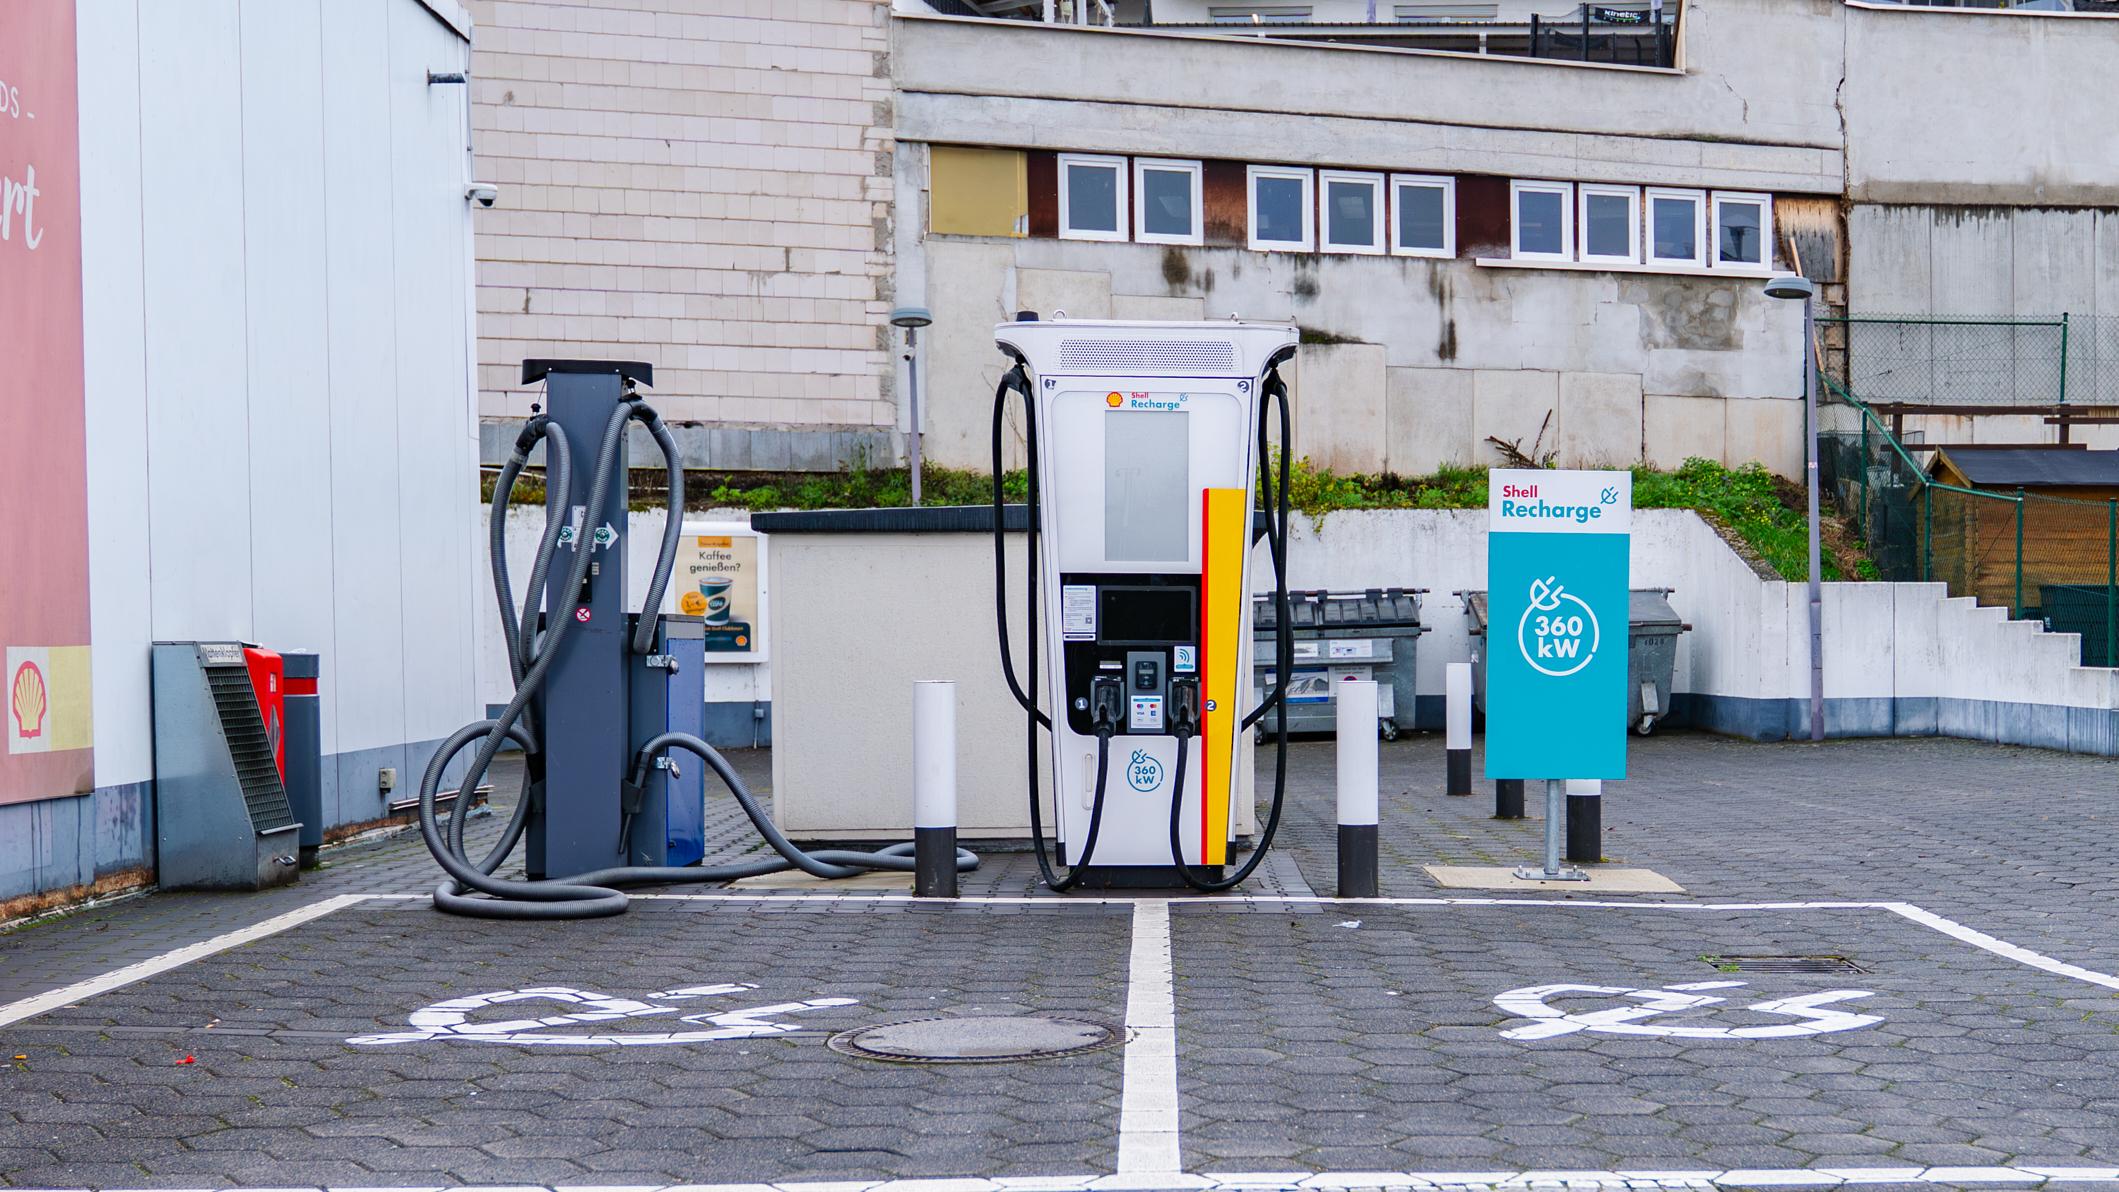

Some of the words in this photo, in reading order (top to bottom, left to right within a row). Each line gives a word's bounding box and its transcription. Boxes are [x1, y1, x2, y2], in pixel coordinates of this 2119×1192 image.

[1131, 399, 1180, 411] Recharge
[1503, 485, 1538, 498] Shell
[1502, 500, 1602, 523] Recharge
[699, 551, 732, 561] Kaffee
[689, 562, 741, 574] genießen?
[1534, 616, 1584, 637] 360
[1537, 637, 1581, 659] kW
[1134, 766, 1156, 775] 360
[1135, 775, 1155, 784] kW
